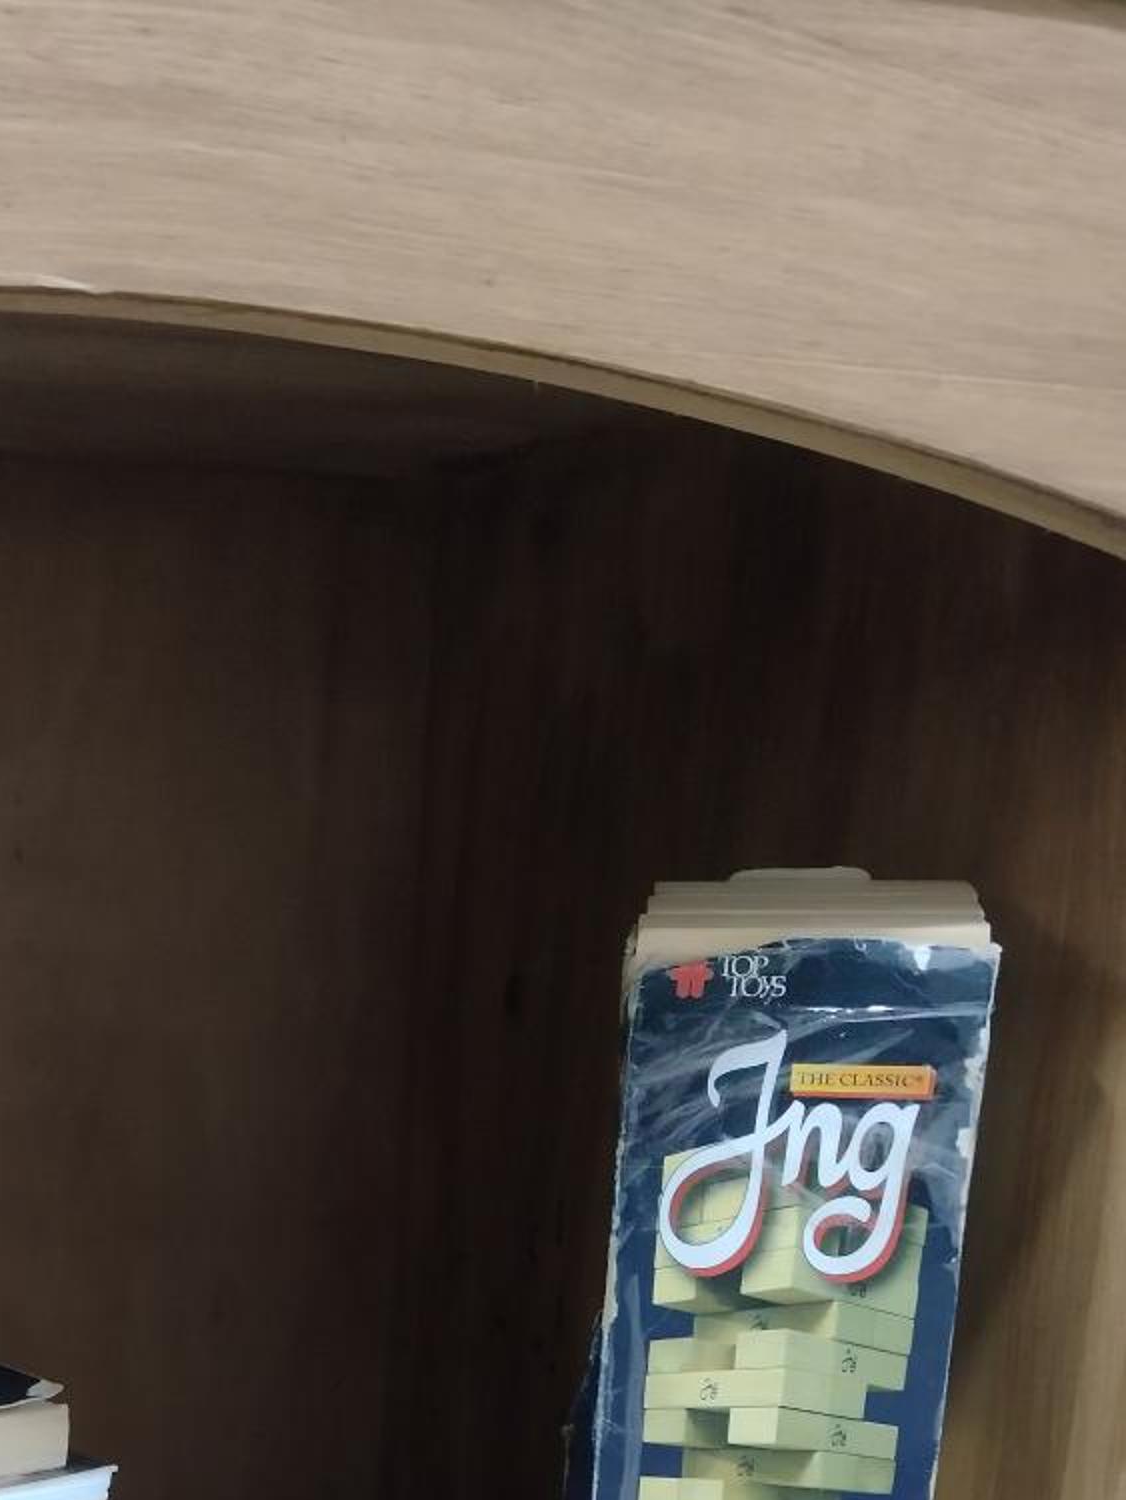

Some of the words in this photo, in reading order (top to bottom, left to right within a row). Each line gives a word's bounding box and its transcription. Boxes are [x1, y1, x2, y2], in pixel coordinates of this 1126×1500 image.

[721, 954, 770, 977] TOP
[729, 975, 787, 998] TOYS
[799, 1071, 835, 1086] THE
